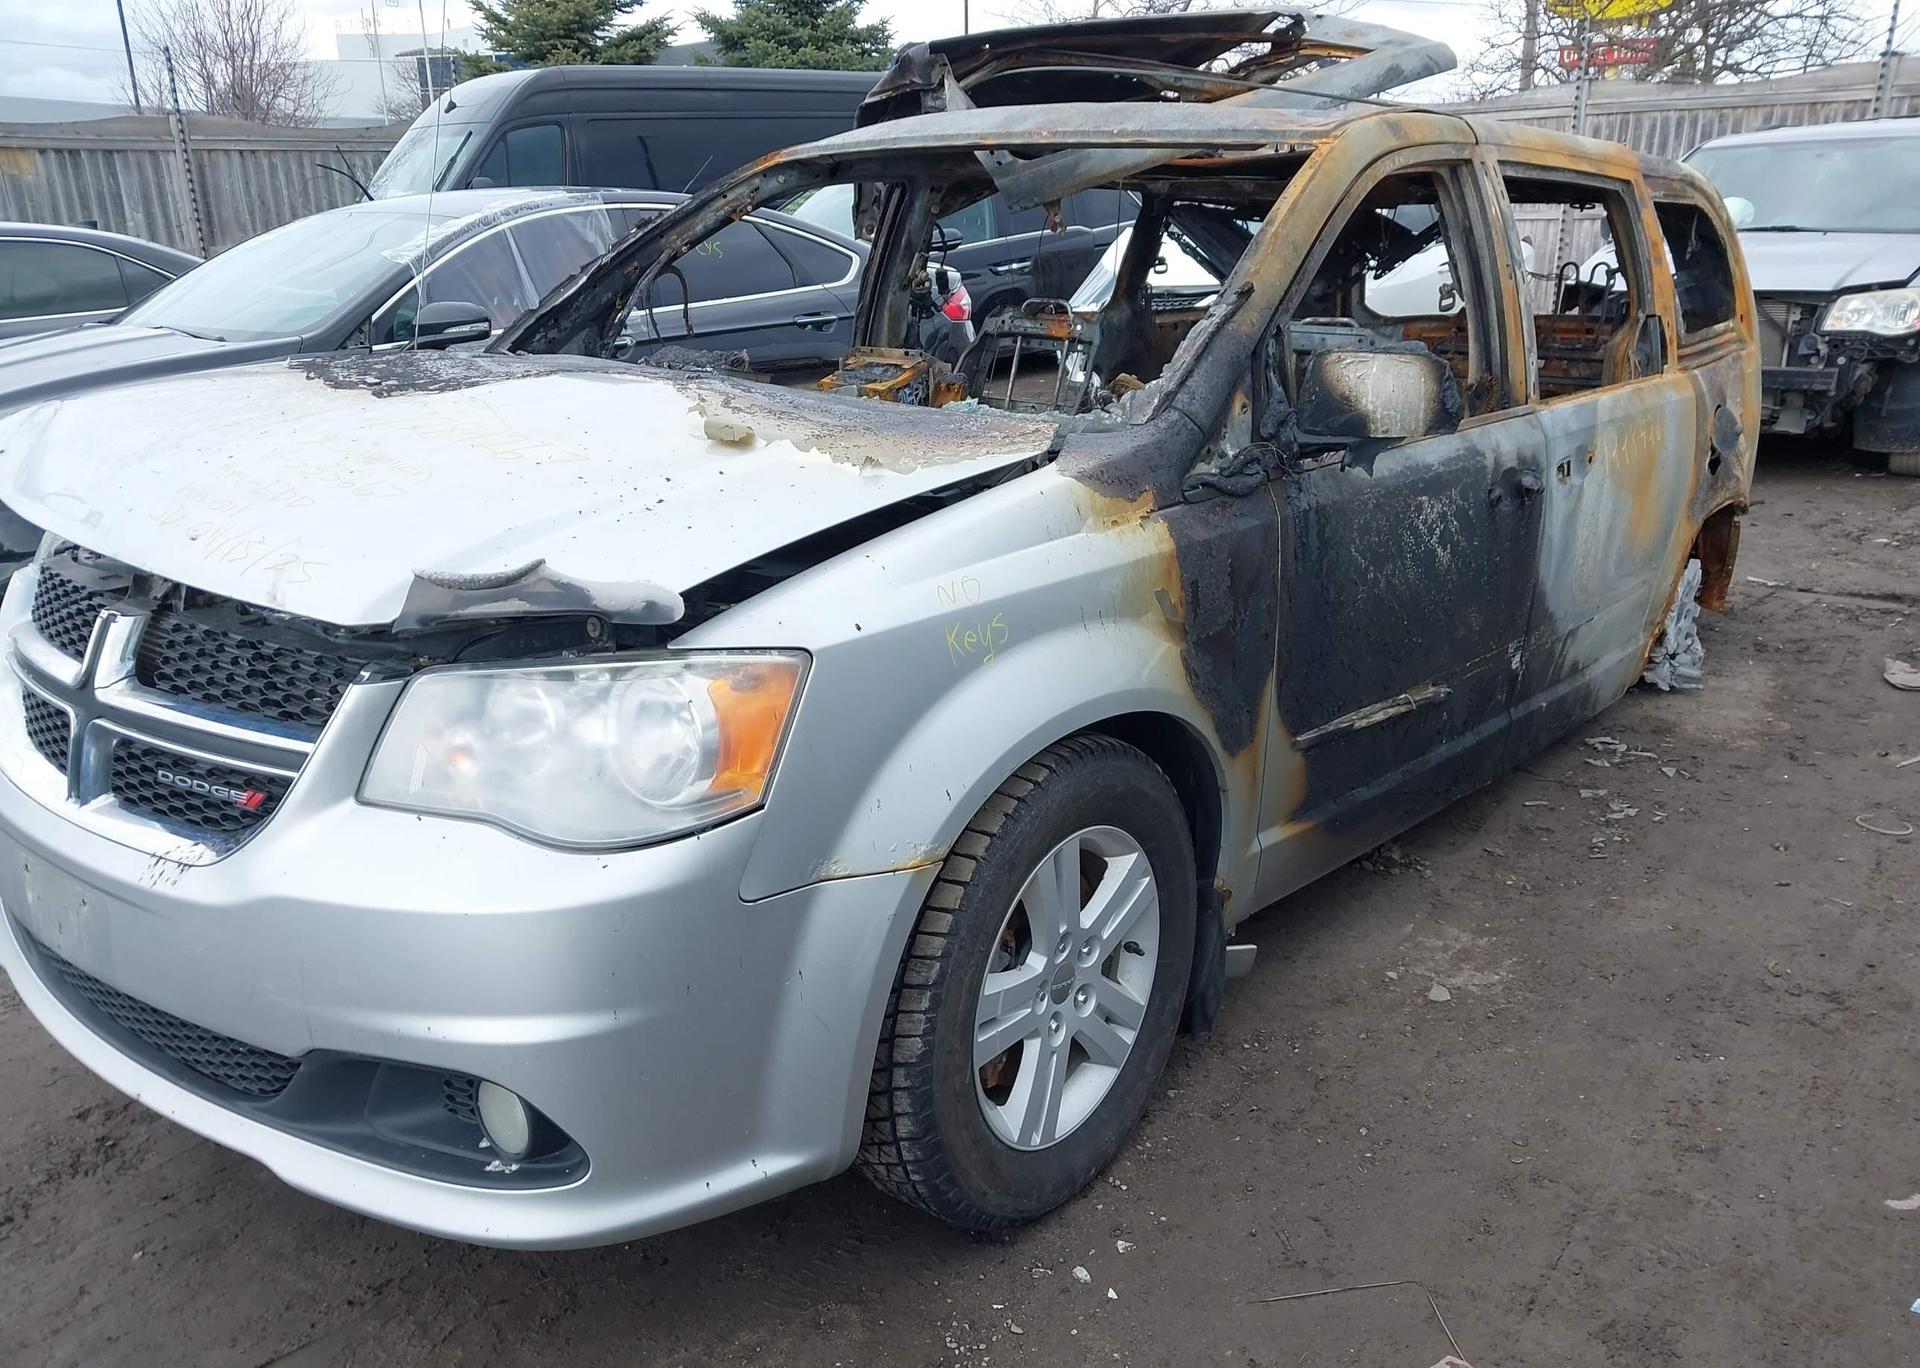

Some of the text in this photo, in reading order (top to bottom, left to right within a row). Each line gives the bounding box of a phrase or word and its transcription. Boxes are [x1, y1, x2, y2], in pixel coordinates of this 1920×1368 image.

[936, 575, 982, 606] NO
[944, 611, 1010, 668] Keys
[156, 769, 249, 804] DODGE
